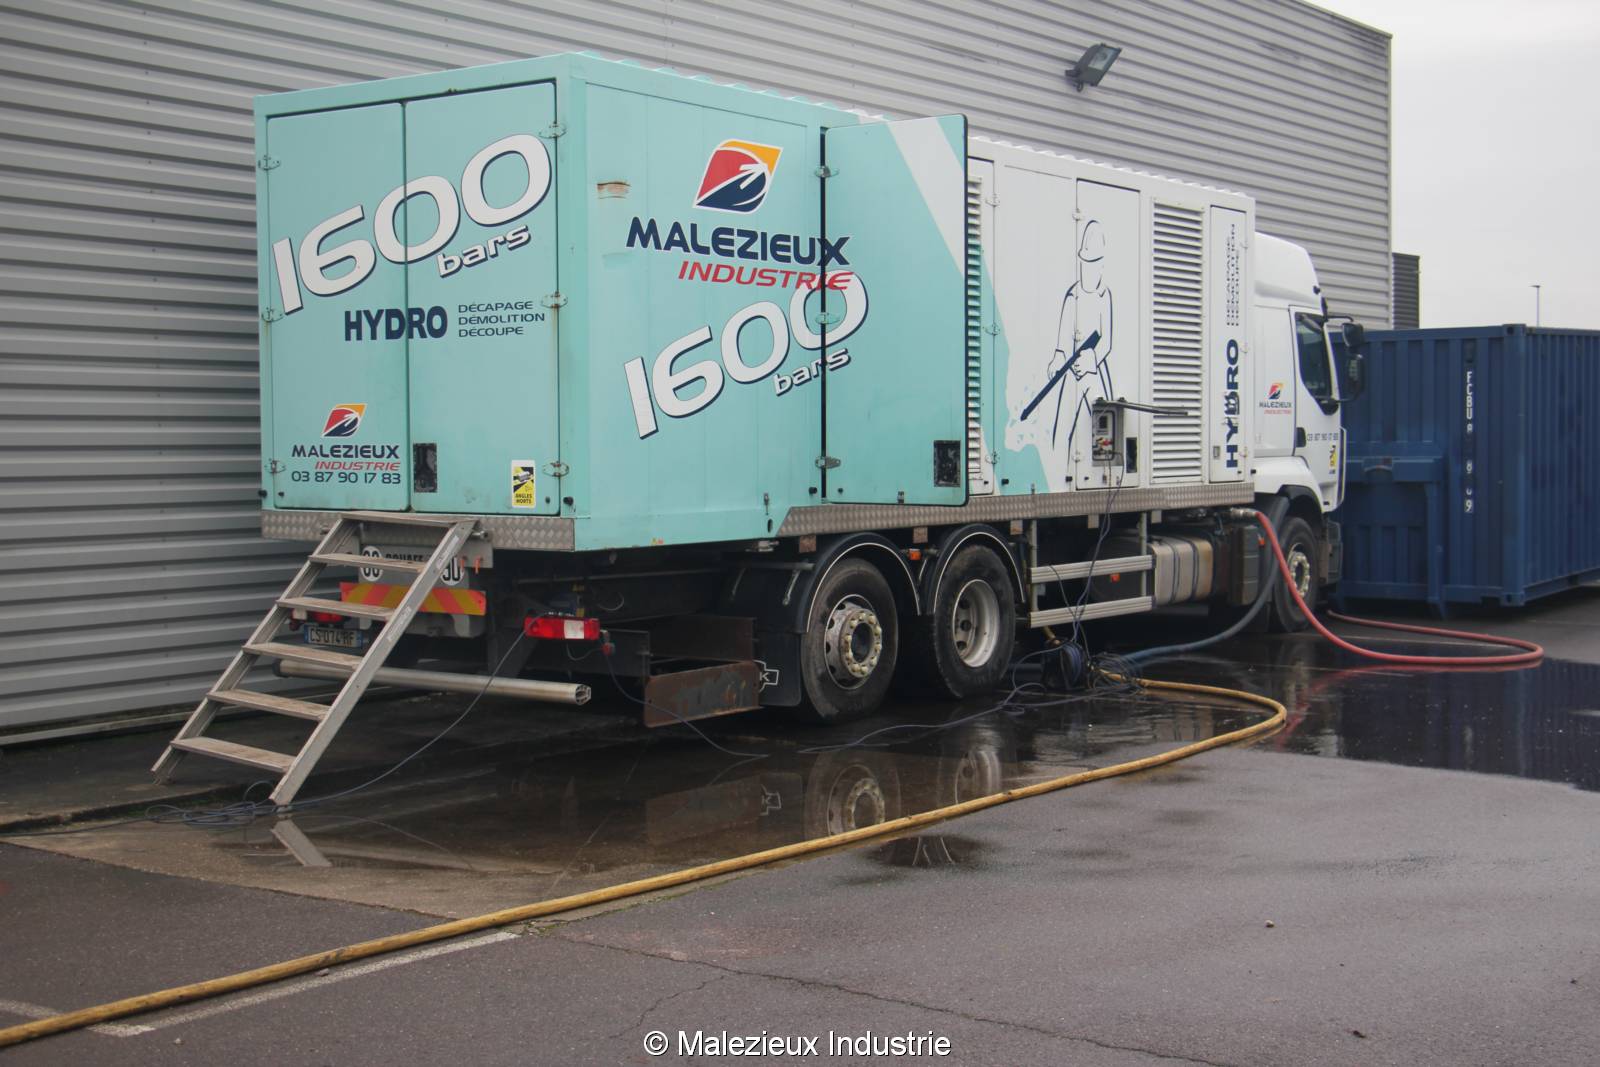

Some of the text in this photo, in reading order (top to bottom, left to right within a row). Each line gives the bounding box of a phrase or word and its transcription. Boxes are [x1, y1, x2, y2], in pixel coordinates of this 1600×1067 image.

[273, 133, 552, 315] 1600
[437, 225, 532, 277] bars
[625, 216, 850, 266] MALEZIEUX
[677, 261, 854, 291] INDUSTRIE
[458, 301, 534, 314] DÉCAPAGE
[458, 313, 545, 326] DÉMOLITION
[344, 306, 448, 341] HYDRO
[458, 326, 524, 338] DÉCOUPE
[624, 270, 869, 439] 1600
[773, 348, 851, 396] bars
[291, 444, 400, 459] MALEZIEUX
[314, 461, 401, 471] INDUSTRIE
[291, 471, 401, 484] 03 87 90 17 83
